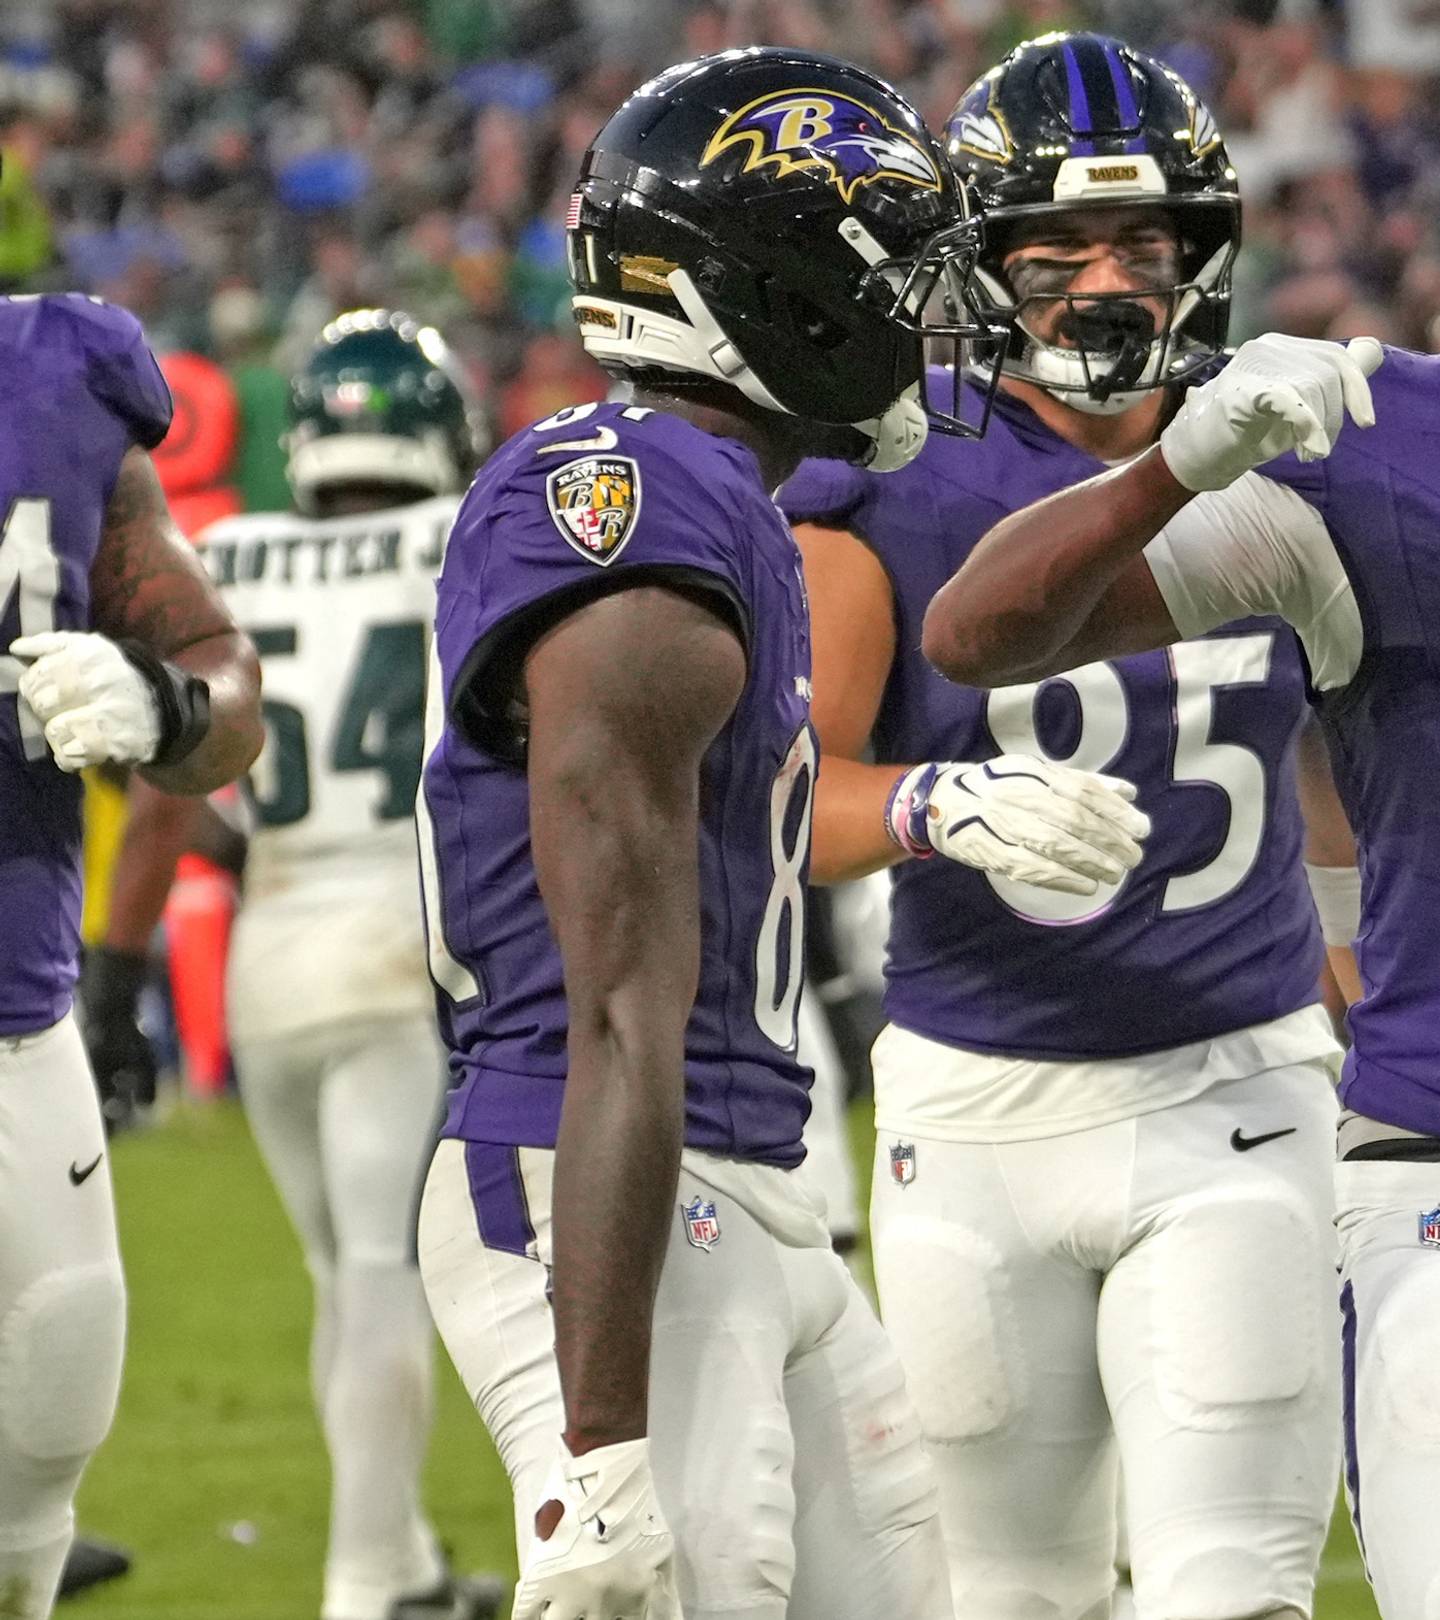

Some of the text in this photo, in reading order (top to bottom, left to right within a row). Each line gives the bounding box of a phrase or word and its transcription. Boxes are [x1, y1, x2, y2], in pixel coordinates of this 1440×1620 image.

[750, 98, 834, 151] B
[1086, 166, 1138, 182] RAVENS
[556, 461, 627, 487] RAVENS
[985, 633, 1275, 928] 85
[693, 1220, 718, 1241] NFL
